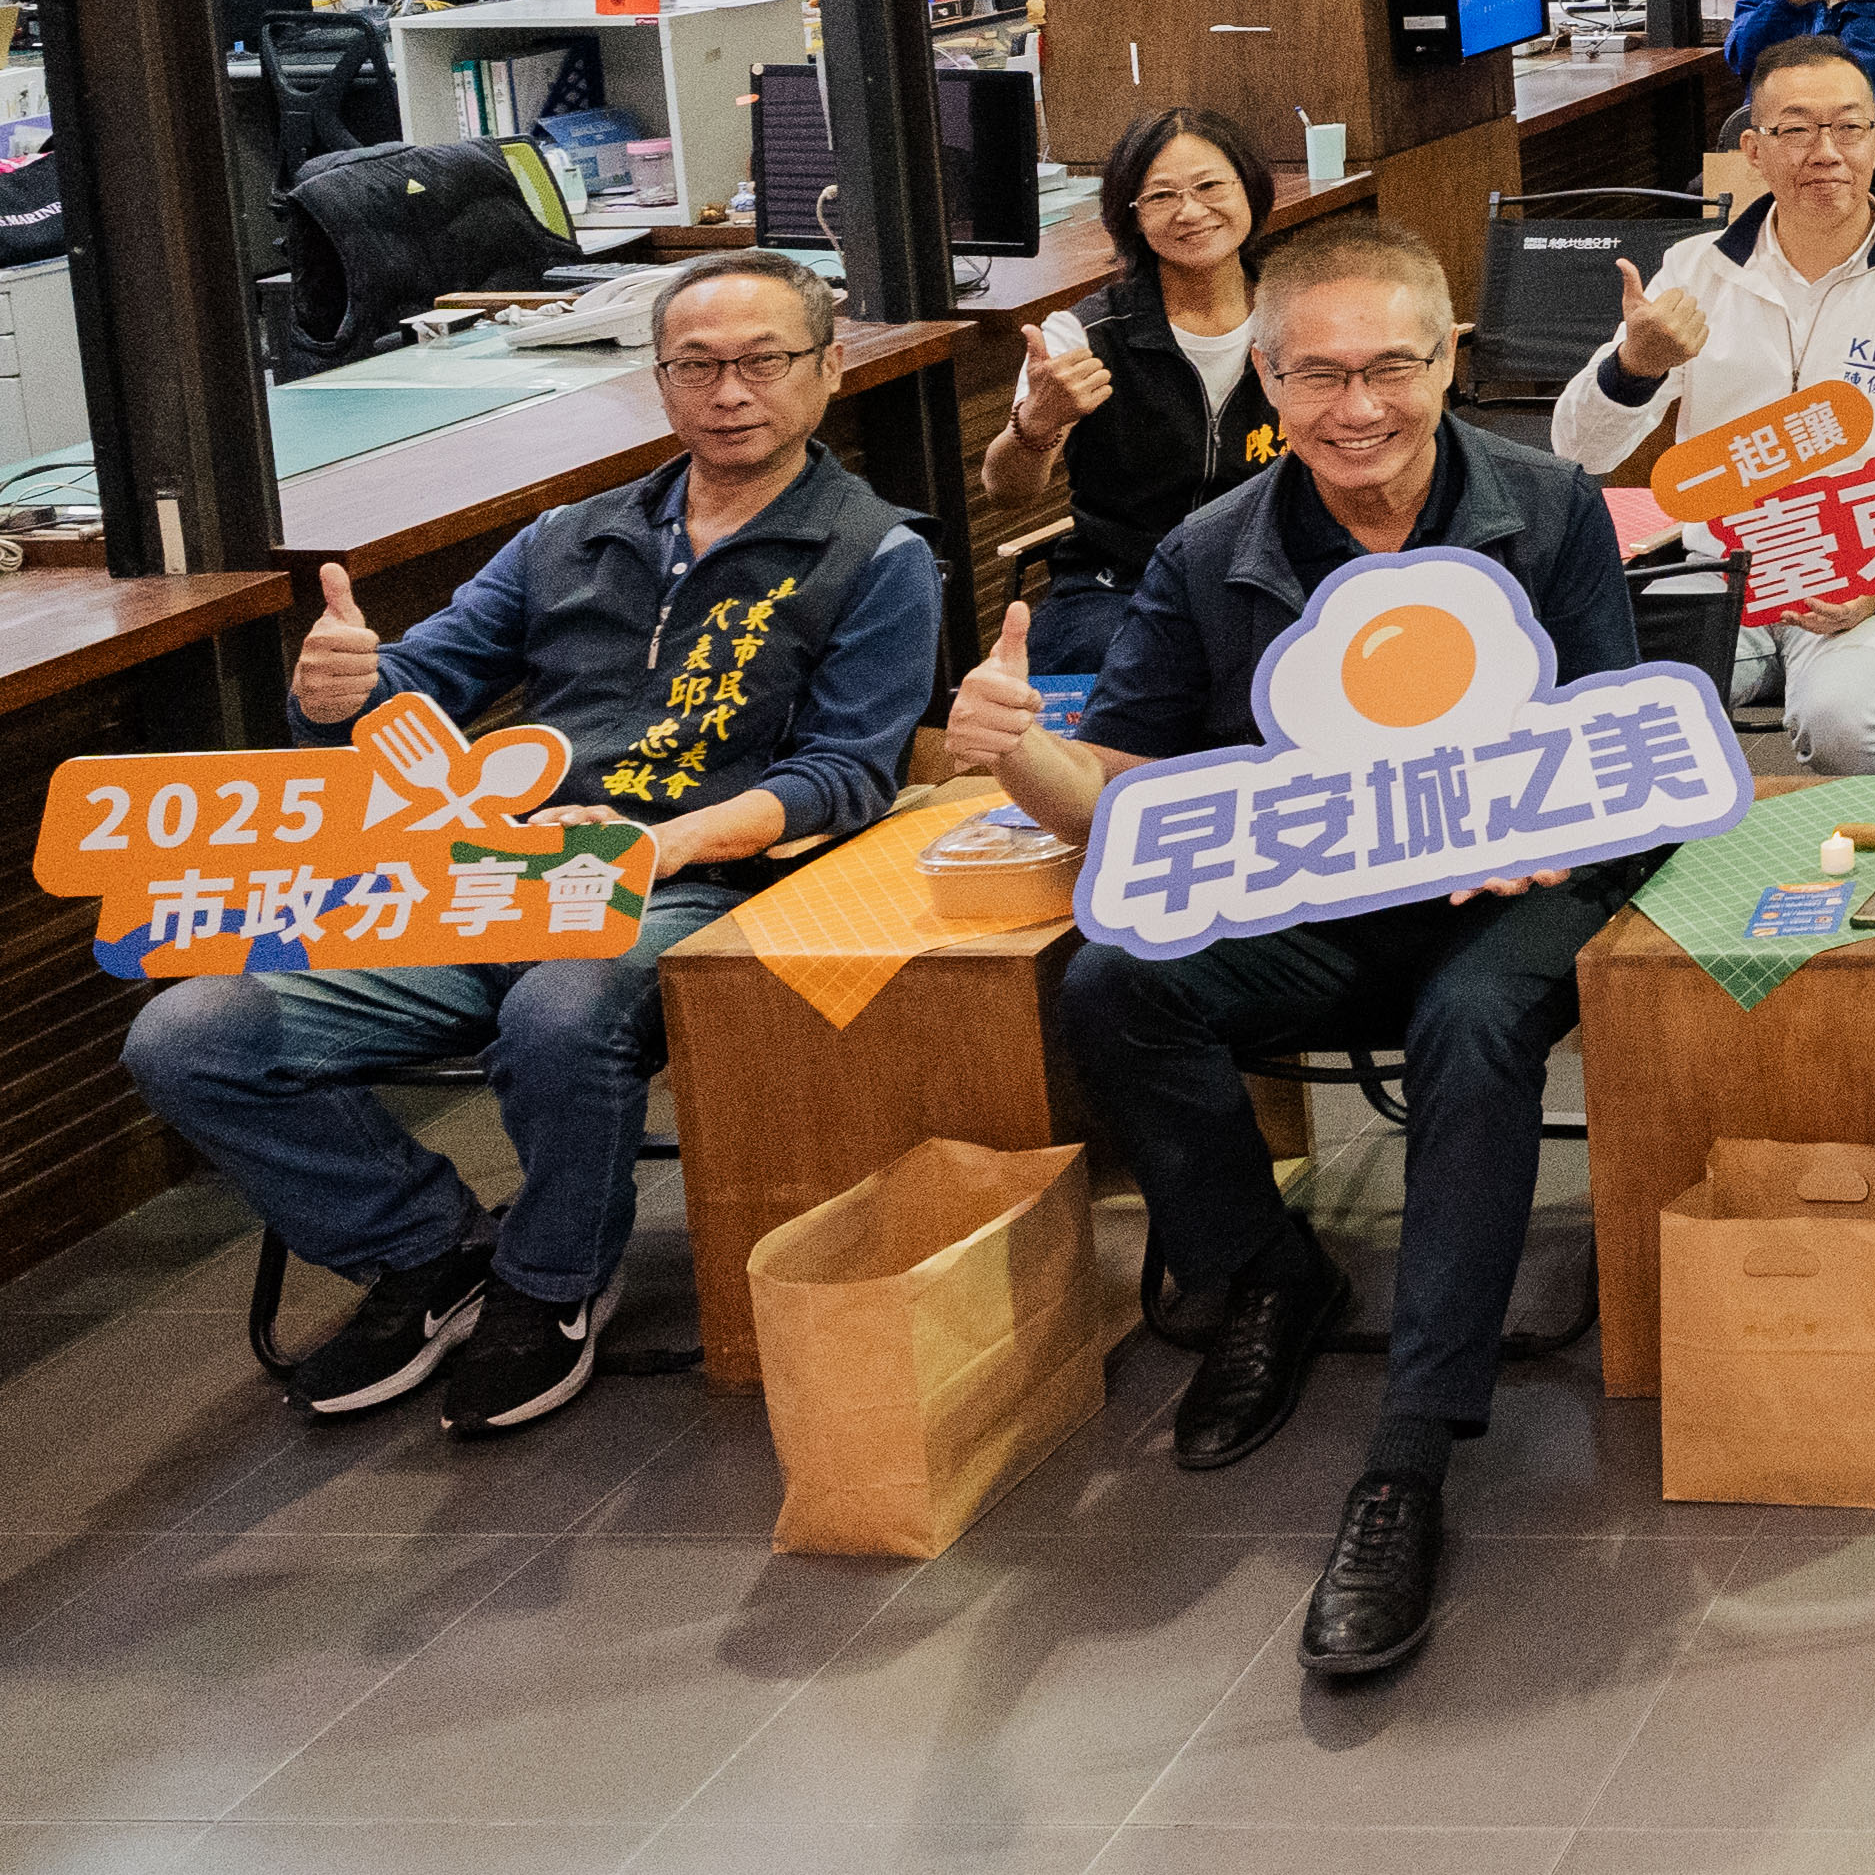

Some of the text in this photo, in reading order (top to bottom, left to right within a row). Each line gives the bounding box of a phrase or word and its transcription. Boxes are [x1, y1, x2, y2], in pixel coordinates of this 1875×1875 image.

[1675, 398, 1849, 492] 一起讓
[601, 575, 798, 802] 代表邱忠敏 臺東市民代表會
[78, 775, 328, 853] 2025
[1122, 701, 1711, 916] 早安城之美
[147, 849, 629, 953] 市政分享會
